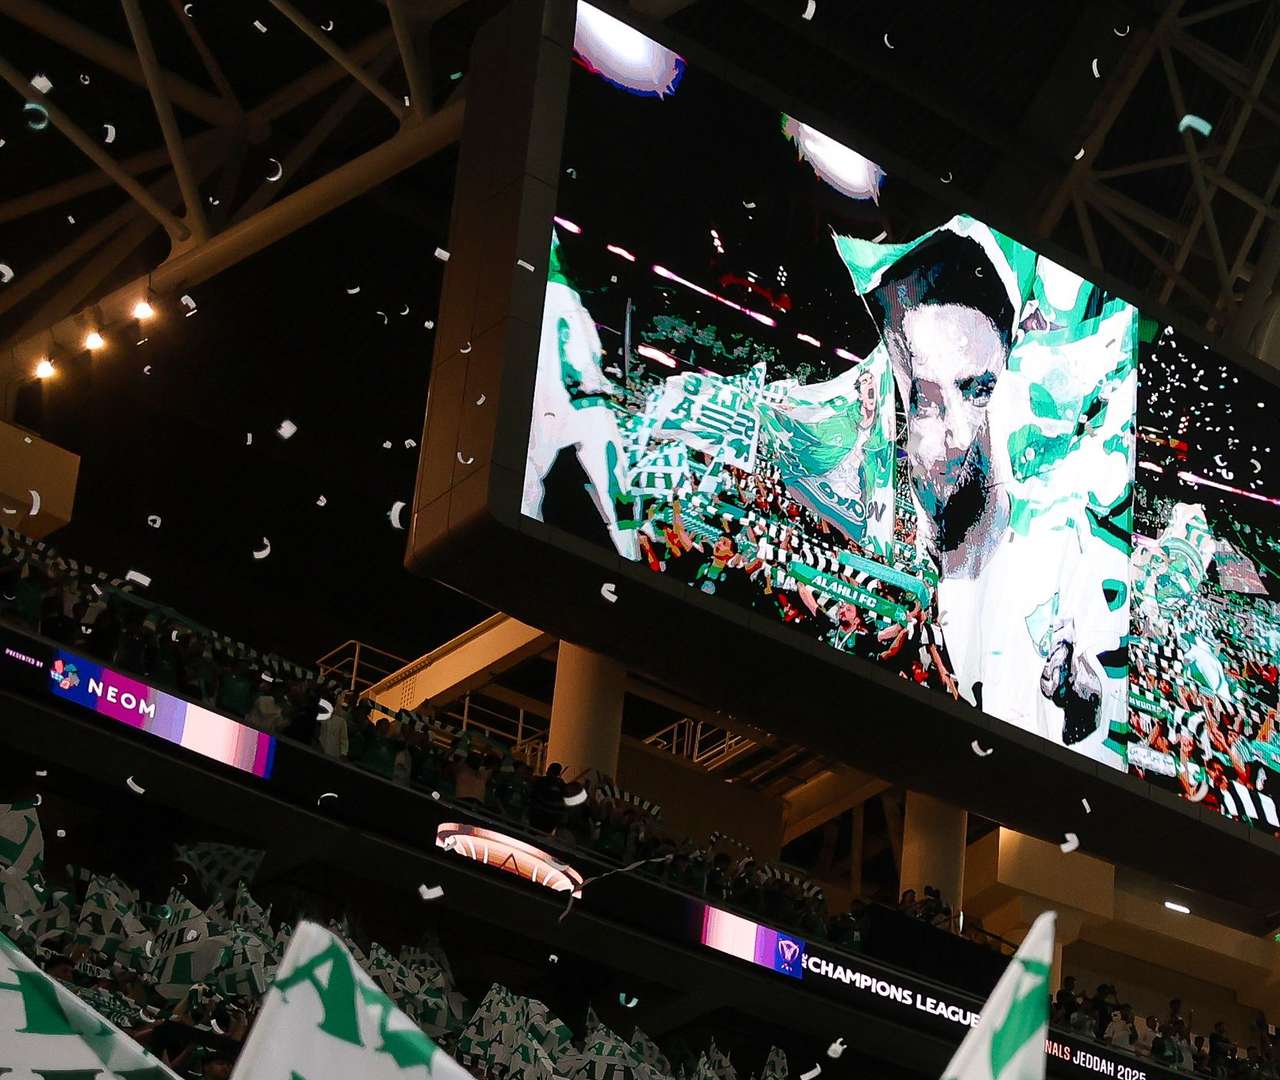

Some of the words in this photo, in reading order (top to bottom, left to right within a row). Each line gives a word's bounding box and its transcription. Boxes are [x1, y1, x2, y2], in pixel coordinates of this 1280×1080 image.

[826, 582, 858, 600] AHLI
[859, 593, 877, 608] FC
[87, 677, 156, 719] NEOM
[808, 956, 913, 1005] CHAMPIONS
[915, 993, 982, 1028] LEAGUE
[1044, 1039, 1071, 1062] NALS
[1073, 1049, 1115, 1077] JEDDAH
